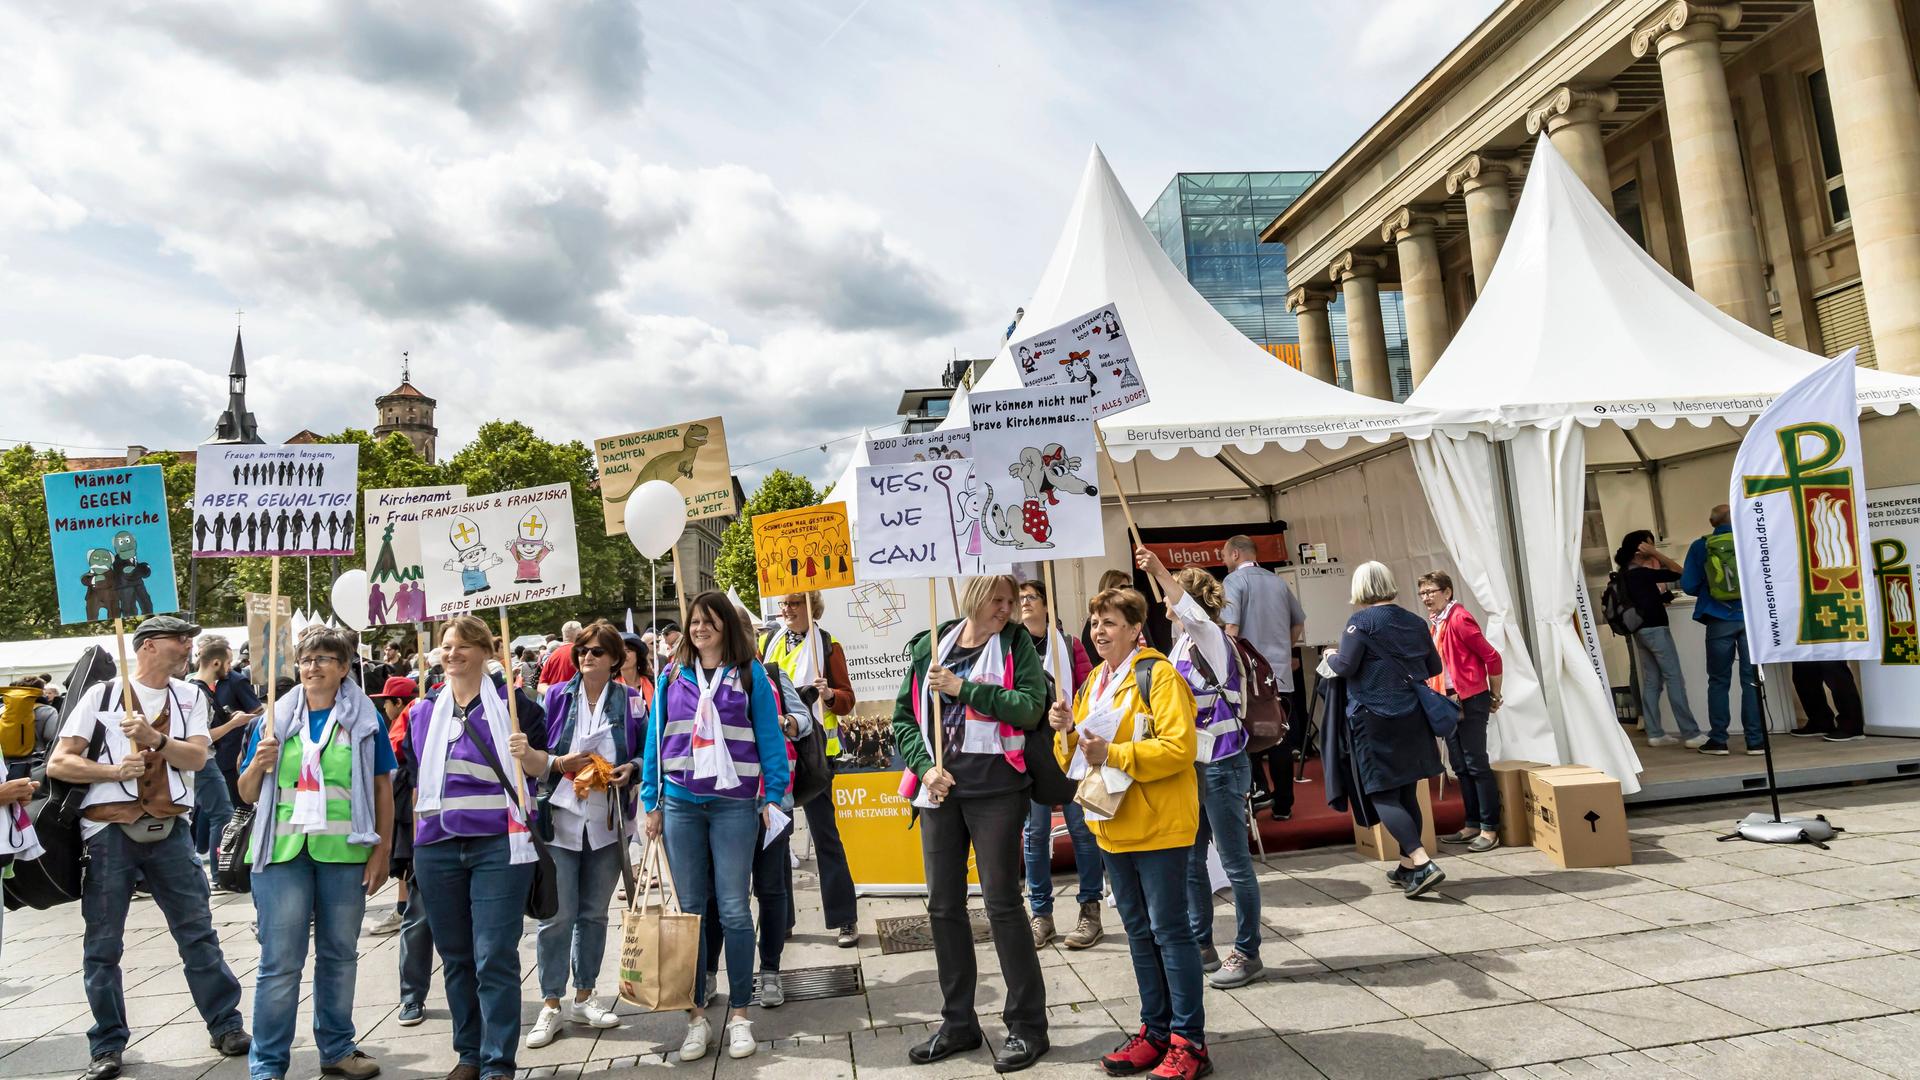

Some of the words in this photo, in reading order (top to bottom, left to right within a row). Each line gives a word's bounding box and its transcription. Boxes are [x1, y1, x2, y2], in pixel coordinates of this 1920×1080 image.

[972, 402, 992, 415] Wir
[995, 398, 1034, 412] können
[1038, 395, 1065, 408] nicht
[1070, 394, 1088, 405] nur
[1102, 398, 1122, 411] ALLES
[1125, 388, 1146, 404] DOOF!
[1673, 398, 1764, 412] Mesnerverband
[972, 419, 1002, 432] brave
[600, 440, 616, 450] DIE
[620, 428, 680, 446] DINOSAURIER
[874, 440, 897, 450] 2000
[902, 438, 924, 448] Jahre
[928, 433, 944, 444] sind
[948, 432, 970, 444] genug
[1127, 427, 1220, 441] Berufsverband
[1225, 426, 1246, 438] der
[224, 451, 255, 460] Frauen
[300, 450, 336, 460] langsam,
[603, 448, 646, 462] DACHTEN
[605, 463, 632, 476] AUCH,
[74, 474, 132, 488] Männer
[870, 472, 928, 496] YES,
[80, 491, 131, 509] GEGEN
[202, 493, 248, 507] ABER
[258, 493, 352, 507] GEWALTIG!
[380, 490, 452, 506] Kirchenamt
[695, 489, 730, 504] HATTEN
[422, 500, 490, 520] FRANZISKUS
[494, 499, 502, 508] &
[508, 489, 568, 506] FRANZISKA
[55, 511, 160, 532] Männerkirche
[368, 513, 380, 524] in
[880, 508, 922, 527] WE
[1868, 510, 1884, 518] DER
[1869, 518, 1920, 528] ROTTENBUR
[869, 542, 936, 564] CAN!
[1168, 548, 1210, 563] leben
[1754, 501, 1781, 646] www.mesnerverband.drs.de
[440, 600, 470, 612] BEIDE
[476, 591, 520, 607] KÖNNEN
[836, 788, 867, 806] BVP
[838, 809, 852, 818] IHR
[855, 808, 898, 818] NETZWERK
